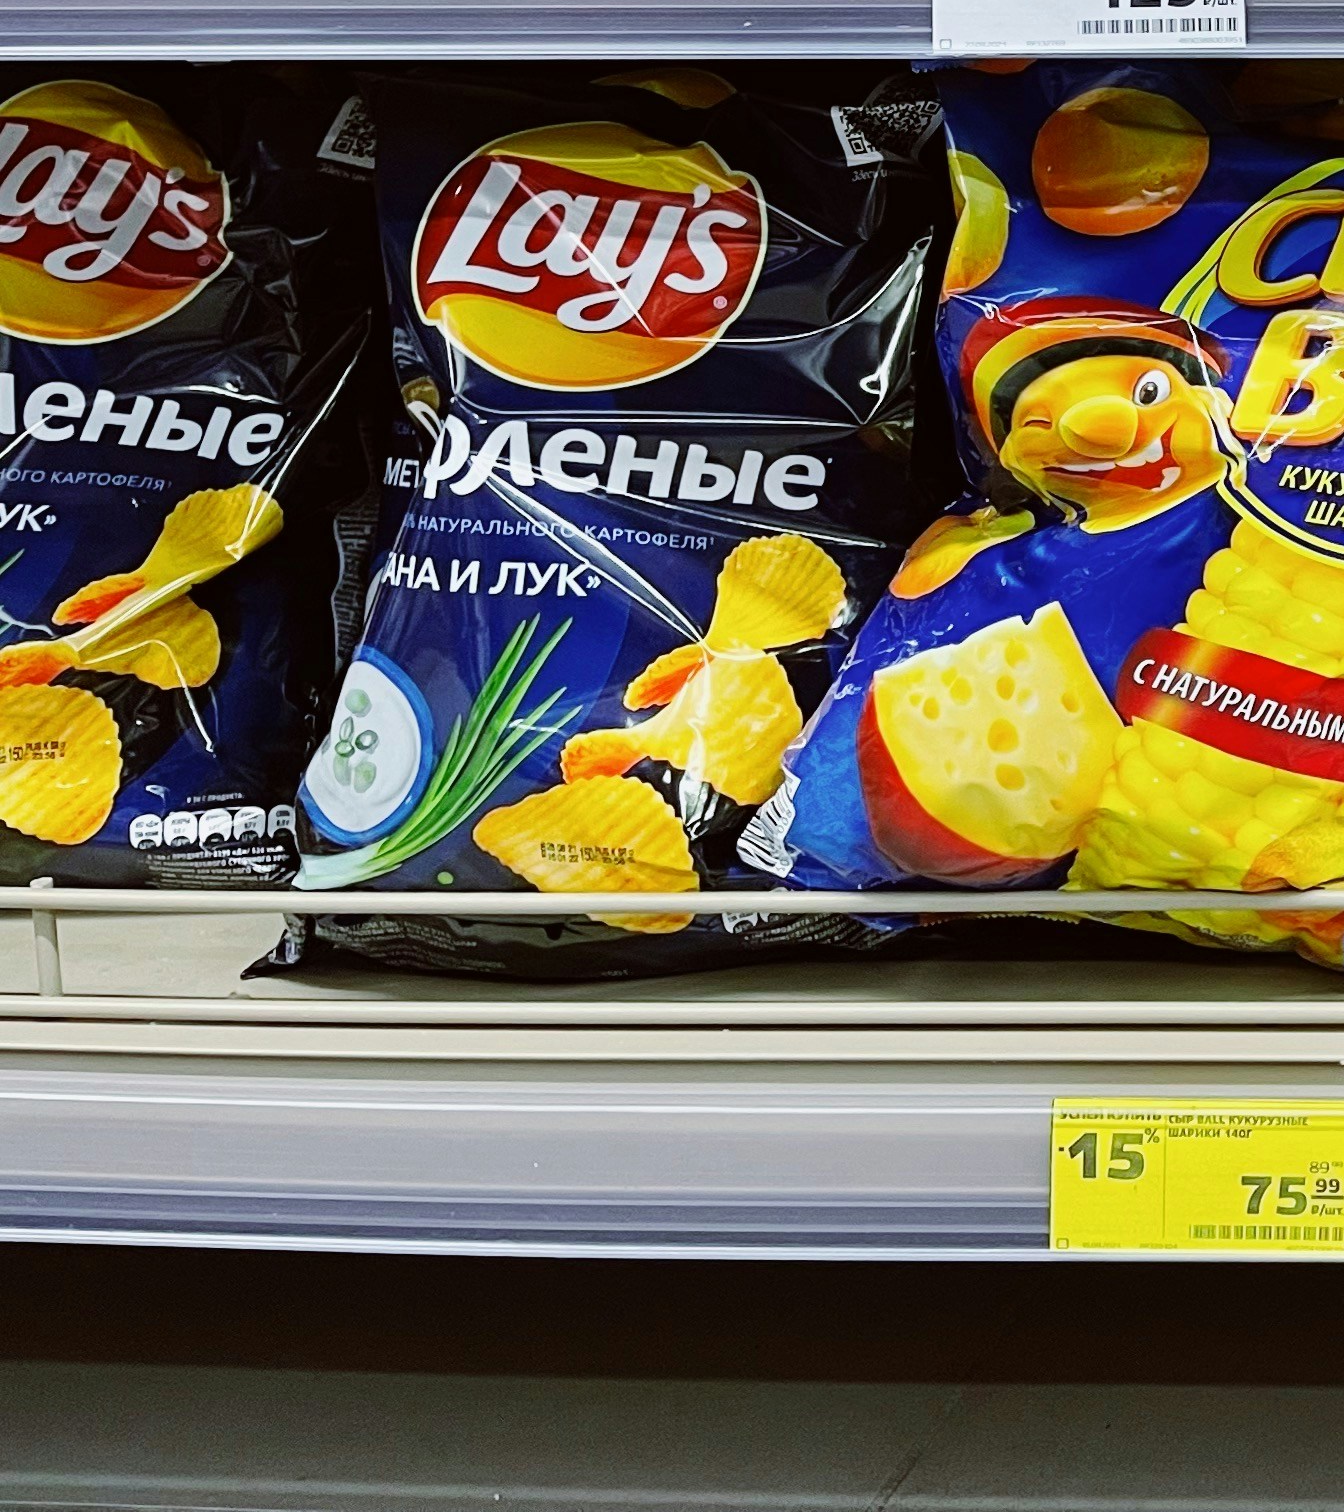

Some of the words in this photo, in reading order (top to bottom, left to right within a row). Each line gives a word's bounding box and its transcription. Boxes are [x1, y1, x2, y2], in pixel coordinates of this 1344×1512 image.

[427, 161, 748, 333] Lay's
[0, 372, 283, 467] еные
[0, 502, 57, 533] УК»
[416, 514, 575, 539] НАТУРАЛЬНОГО
[448, 562, 481, 595] И
[488, 562, 601, 599] ЛУК»
[1132, 658, 1156, 685] С
[1168, 1115, 1194, 1126] СЫР
[1228, 1115, 1309, 1127] КУКУРУЗНЫЕ
[1168, 1127, 1221, 1139] ШАРИКИ
[1225, 1128, 1252, 1139] 140Г
[1309, 1160, 1330, 1174] 89
[1241, 1175, 1308, 1216] 75
[1315, 1178, 1341, 1194] 99
